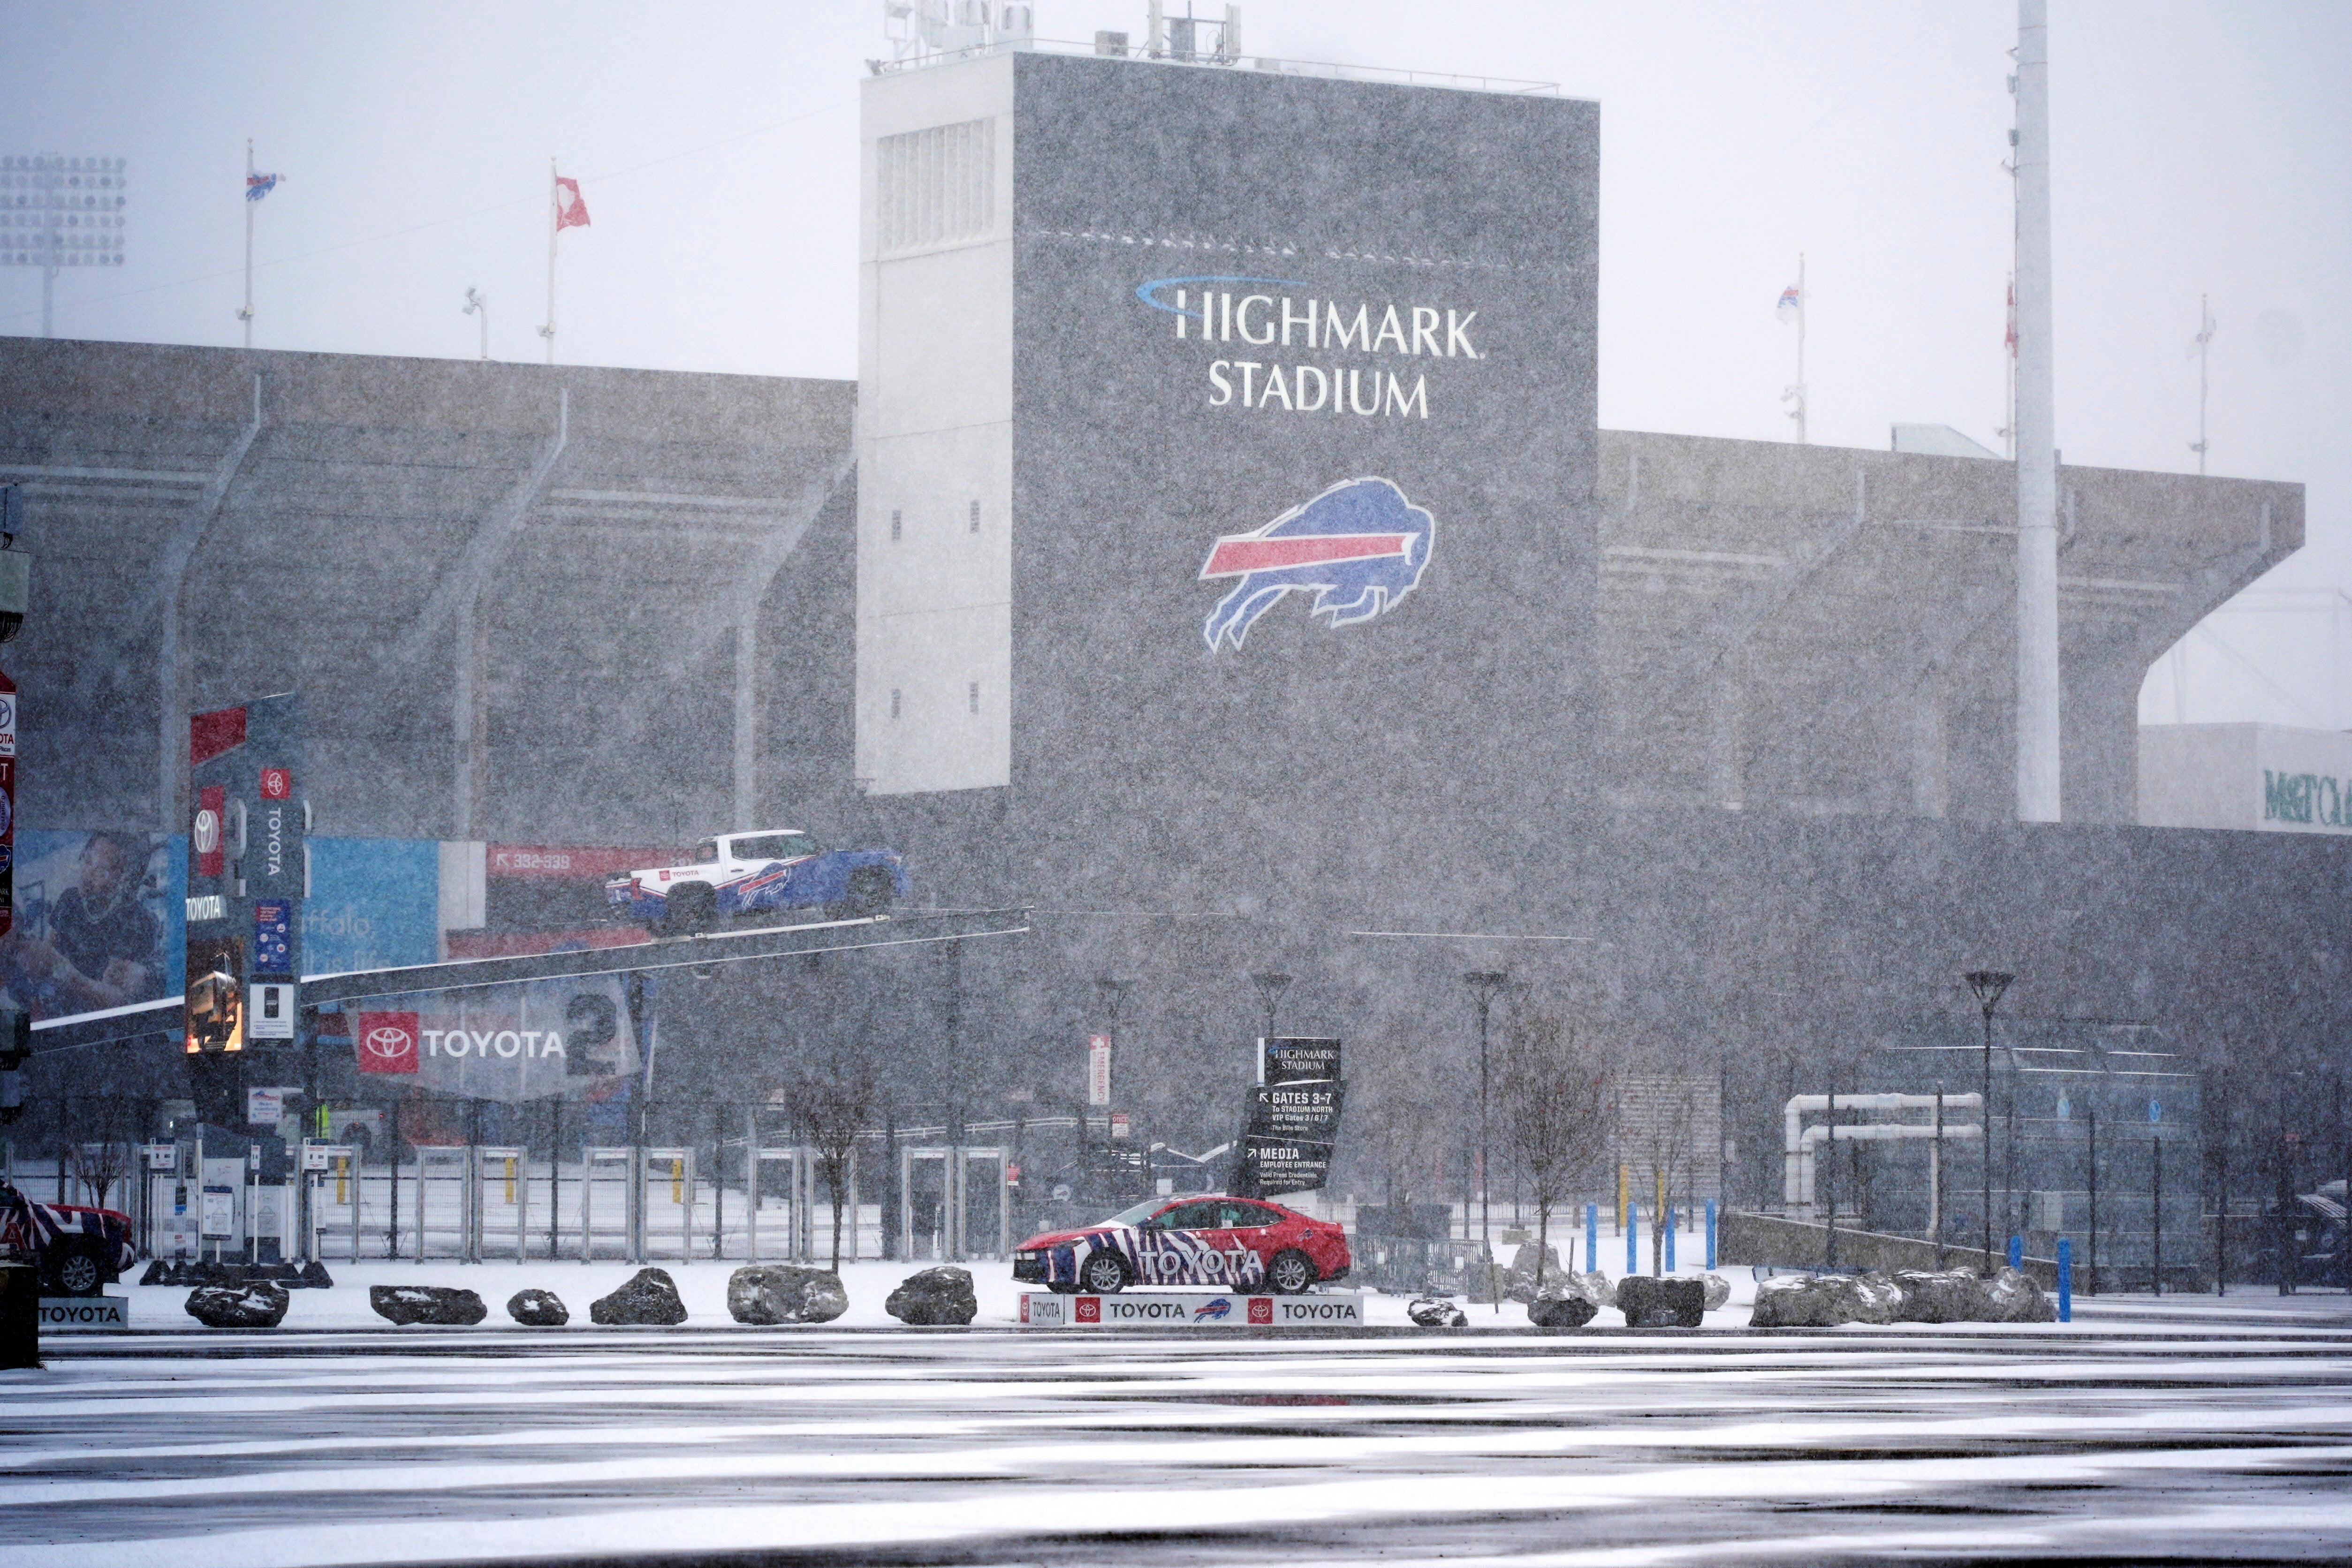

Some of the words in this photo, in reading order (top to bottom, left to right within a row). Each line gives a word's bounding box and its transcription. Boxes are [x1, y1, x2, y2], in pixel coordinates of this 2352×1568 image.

[1176, 289, 1479, 360] HIGHMARK
[1208, 360, 1429, 419] STADIUM
[268, 807, 281, 876] TOYOTA
[185, 895, 221, 920] TOYOTA
[422, 1030, 567, 1058] TOYOTA
[1275, 1049, 1335, 1060] HIGHMARK
[1282, 1061, 1325, 1070] STADIUM
[1097, 1051, 1105, 1102] EMERGENCY
[1272, 1092, 1309, 1104] GATES
[1313, 1093, 1332, 1104] 3-7
[1260, 1148, 1299, 1159] MEDIA
[1138, 1249, 1265, 1275] TOYOTA
[38, 1307, 121, 1322] TOYOTA
[1032, 1301, 1061, 1319] TOYOTA
[1110, 1303, 1186, 1319] TOYOTA
[1282, 1303, 1357, 1320] TOYOTA
